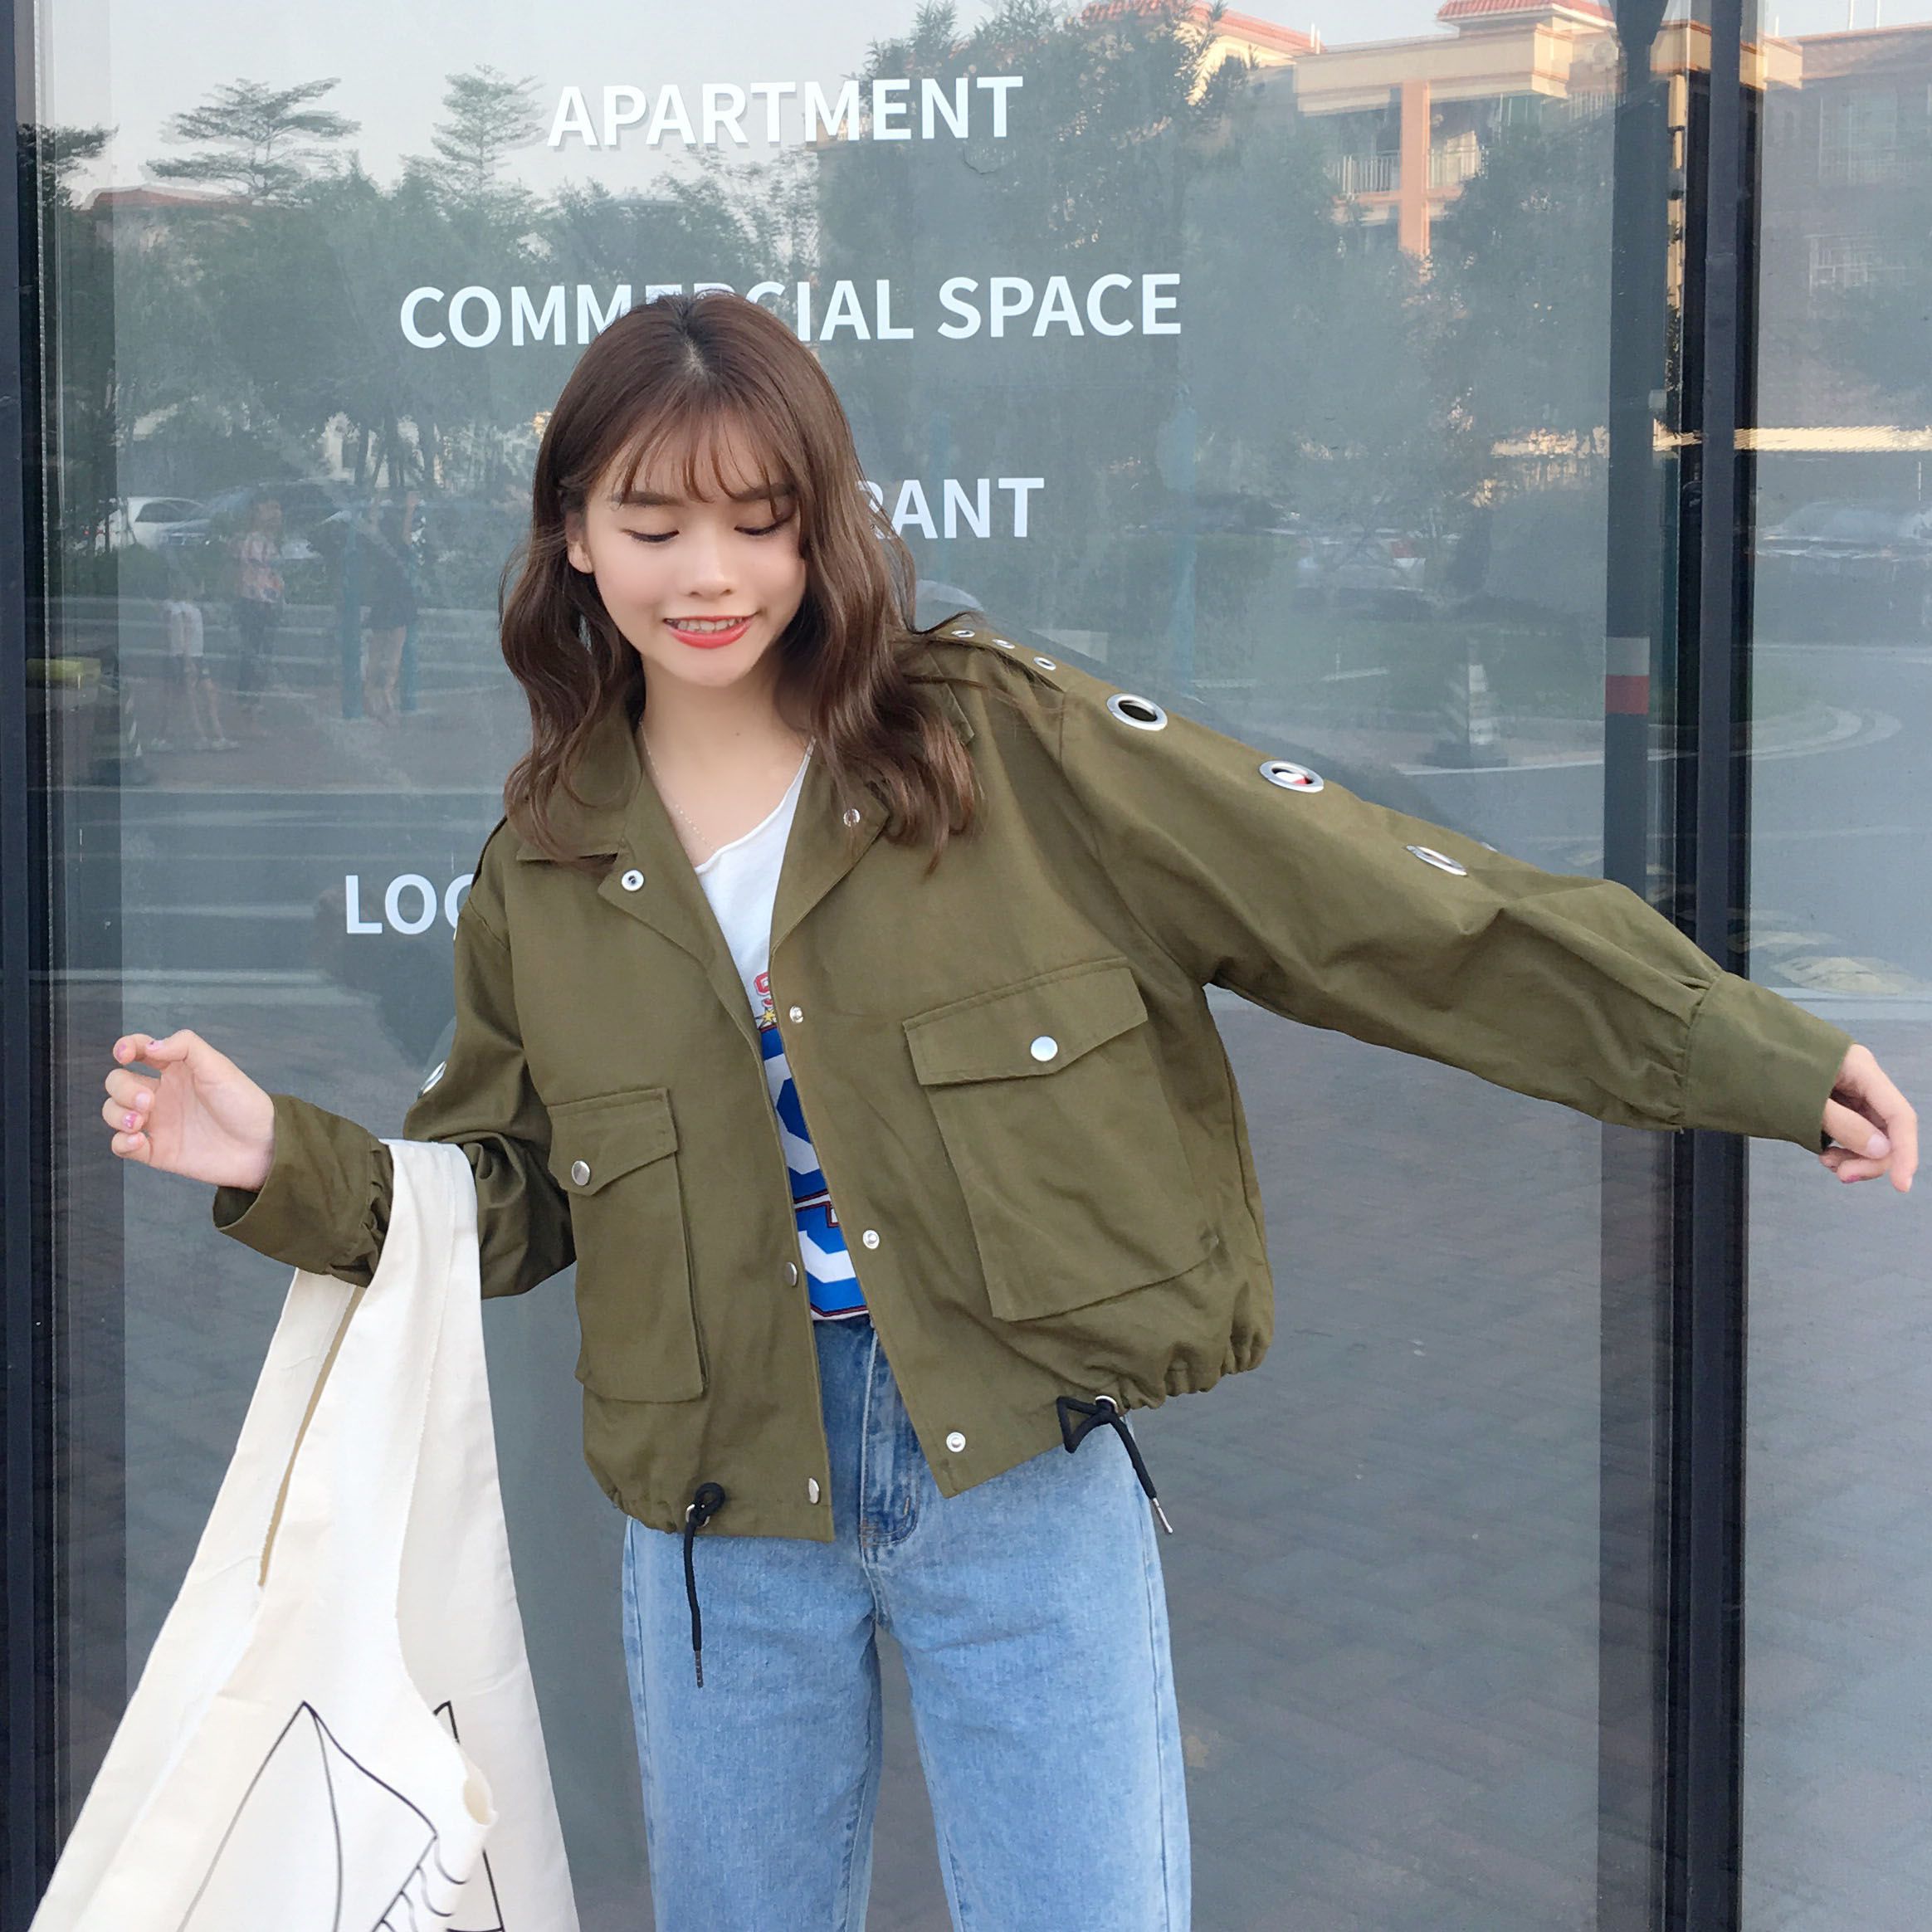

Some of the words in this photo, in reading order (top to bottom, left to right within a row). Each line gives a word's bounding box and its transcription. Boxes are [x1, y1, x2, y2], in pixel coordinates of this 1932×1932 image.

[547, 76, 1024, 148] APARTMENT
[400, 279, 915, 349] COMMIAL
[937, 273, 1182, 339] SPACE
